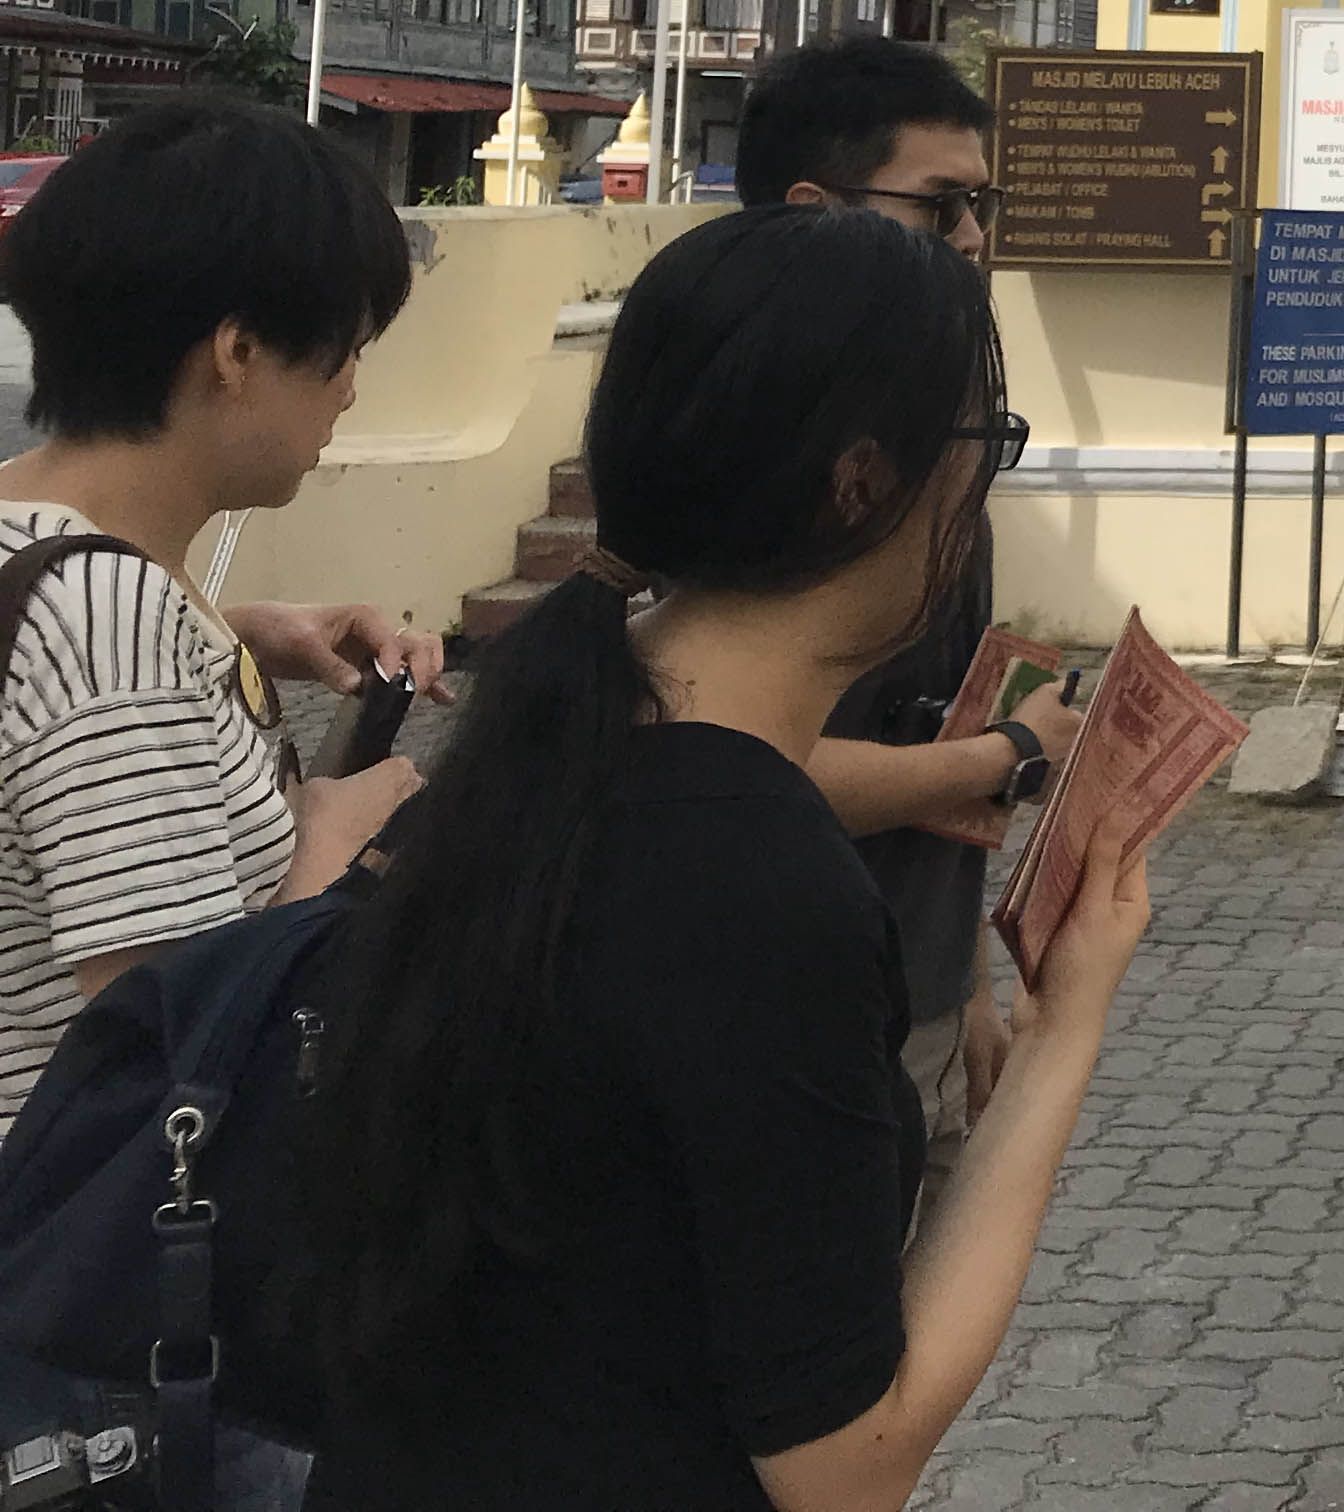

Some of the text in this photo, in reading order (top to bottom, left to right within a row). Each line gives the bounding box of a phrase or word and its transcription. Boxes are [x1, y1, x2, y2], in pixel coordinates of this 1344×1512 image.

[1032, 71, 1220, 90] MASJID MELAYU LEBUH ACEH
[1106, 118, 1140, 132] TOILET
[1303, 157, 1332, 166] MAJLIS
[1071, 182, 1109, 197] OFFICE
[1274, 223, 1334, 240] TEMPAT
[1143, 234, 1173, 248] HALL
[1270, 246, 1286, 261] DI
[1268, 268, 1320, 284] UNTUK
[1265, 290, 1344, 307] PENDUDUK
[1261, 345, 1297, 361] THESE
[1259, 368, 1289, 384] FOR
[1256, 391, 1289, 407] AND
